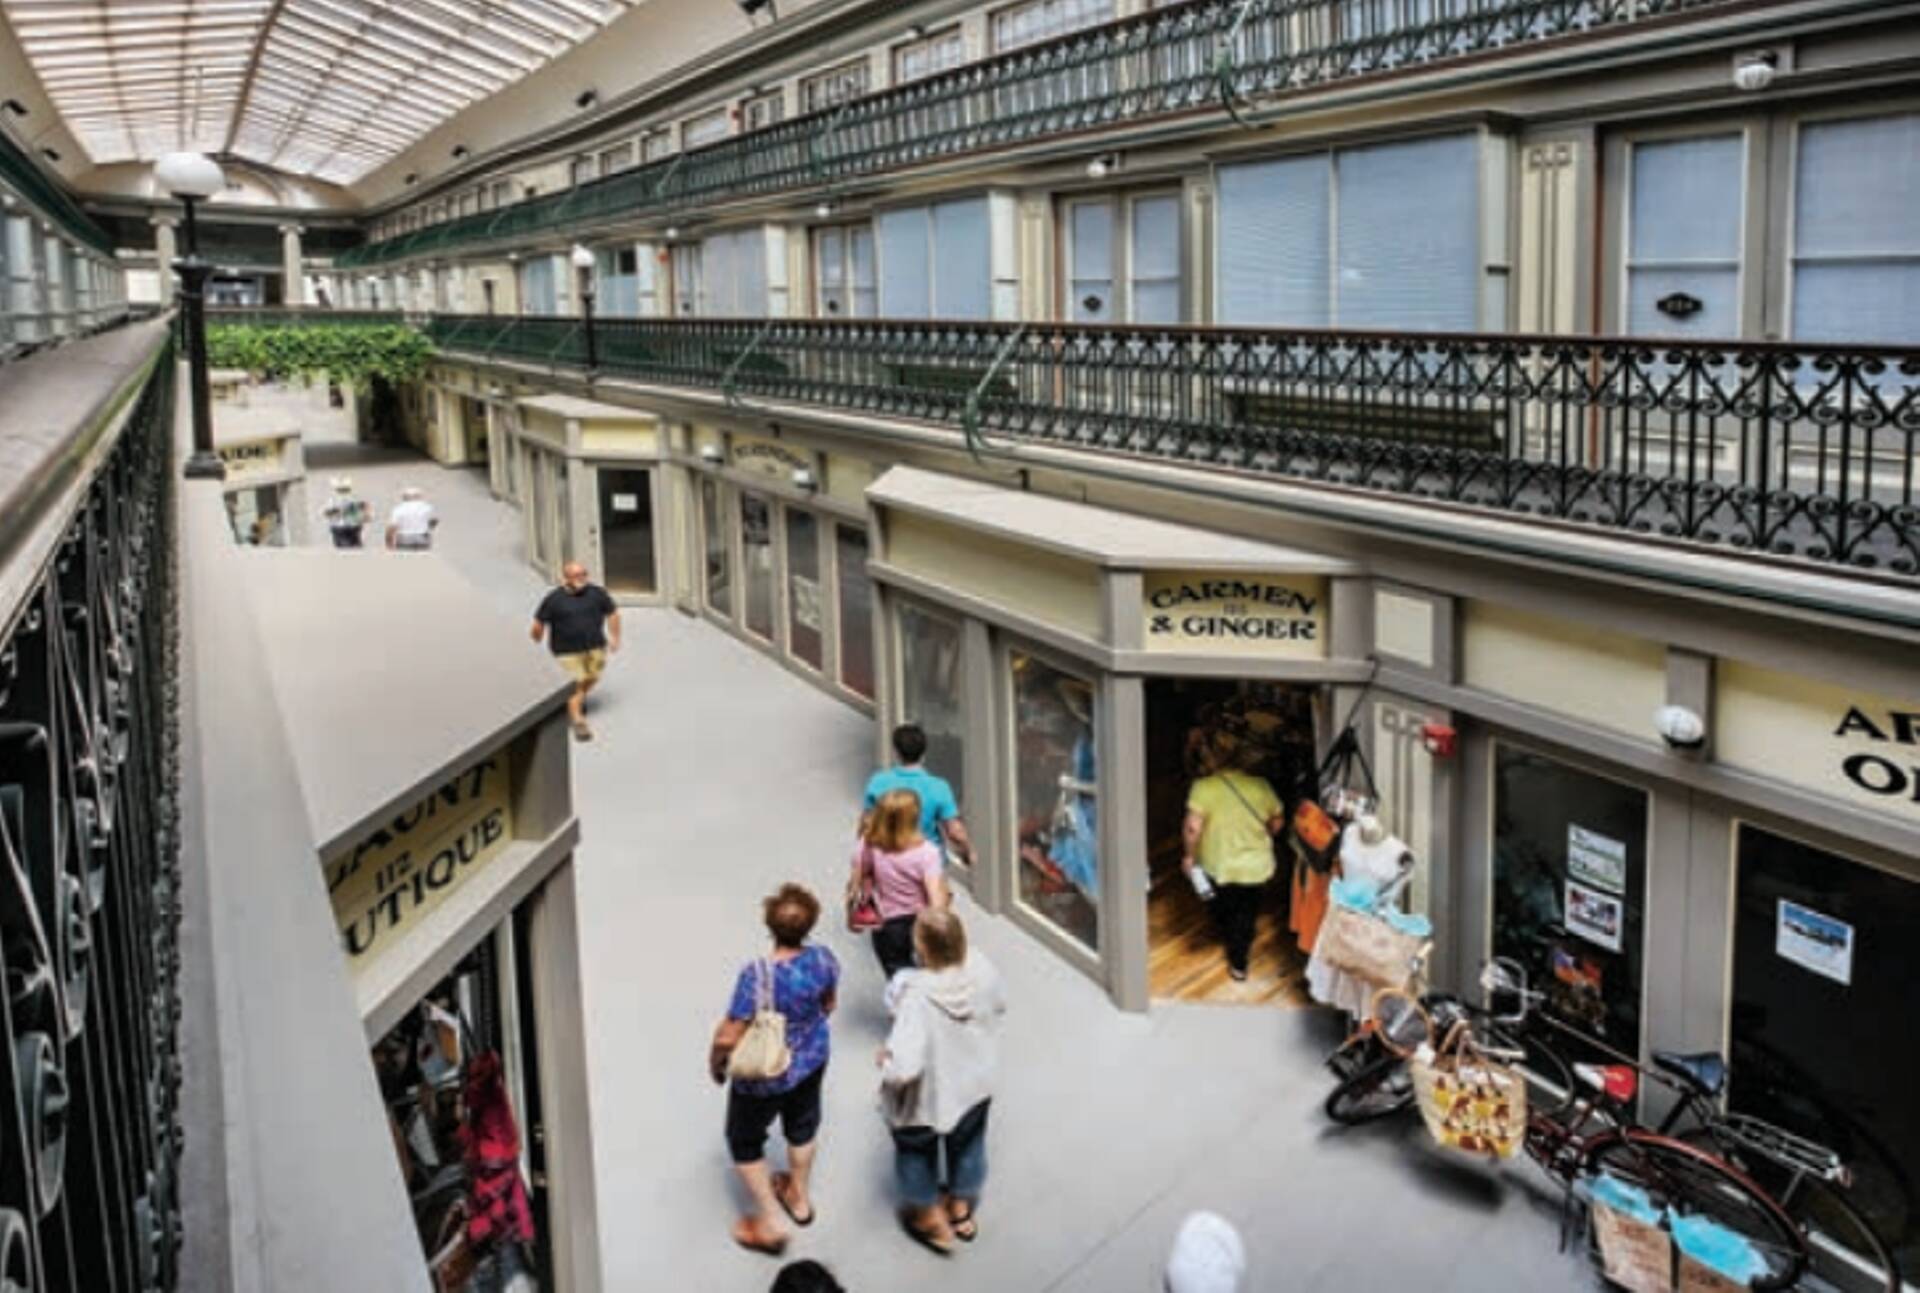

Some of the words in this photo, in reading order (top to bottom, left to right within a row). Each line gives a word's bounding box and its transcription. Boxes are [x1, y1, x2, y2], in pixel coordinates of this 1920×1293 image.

[1151, 580, 1317, 615] CARMEN
[1150, 615, 1173, 633] &
[1182, 615, 1317, 640] GINGER
[1841, 752, 1920, 803] O
